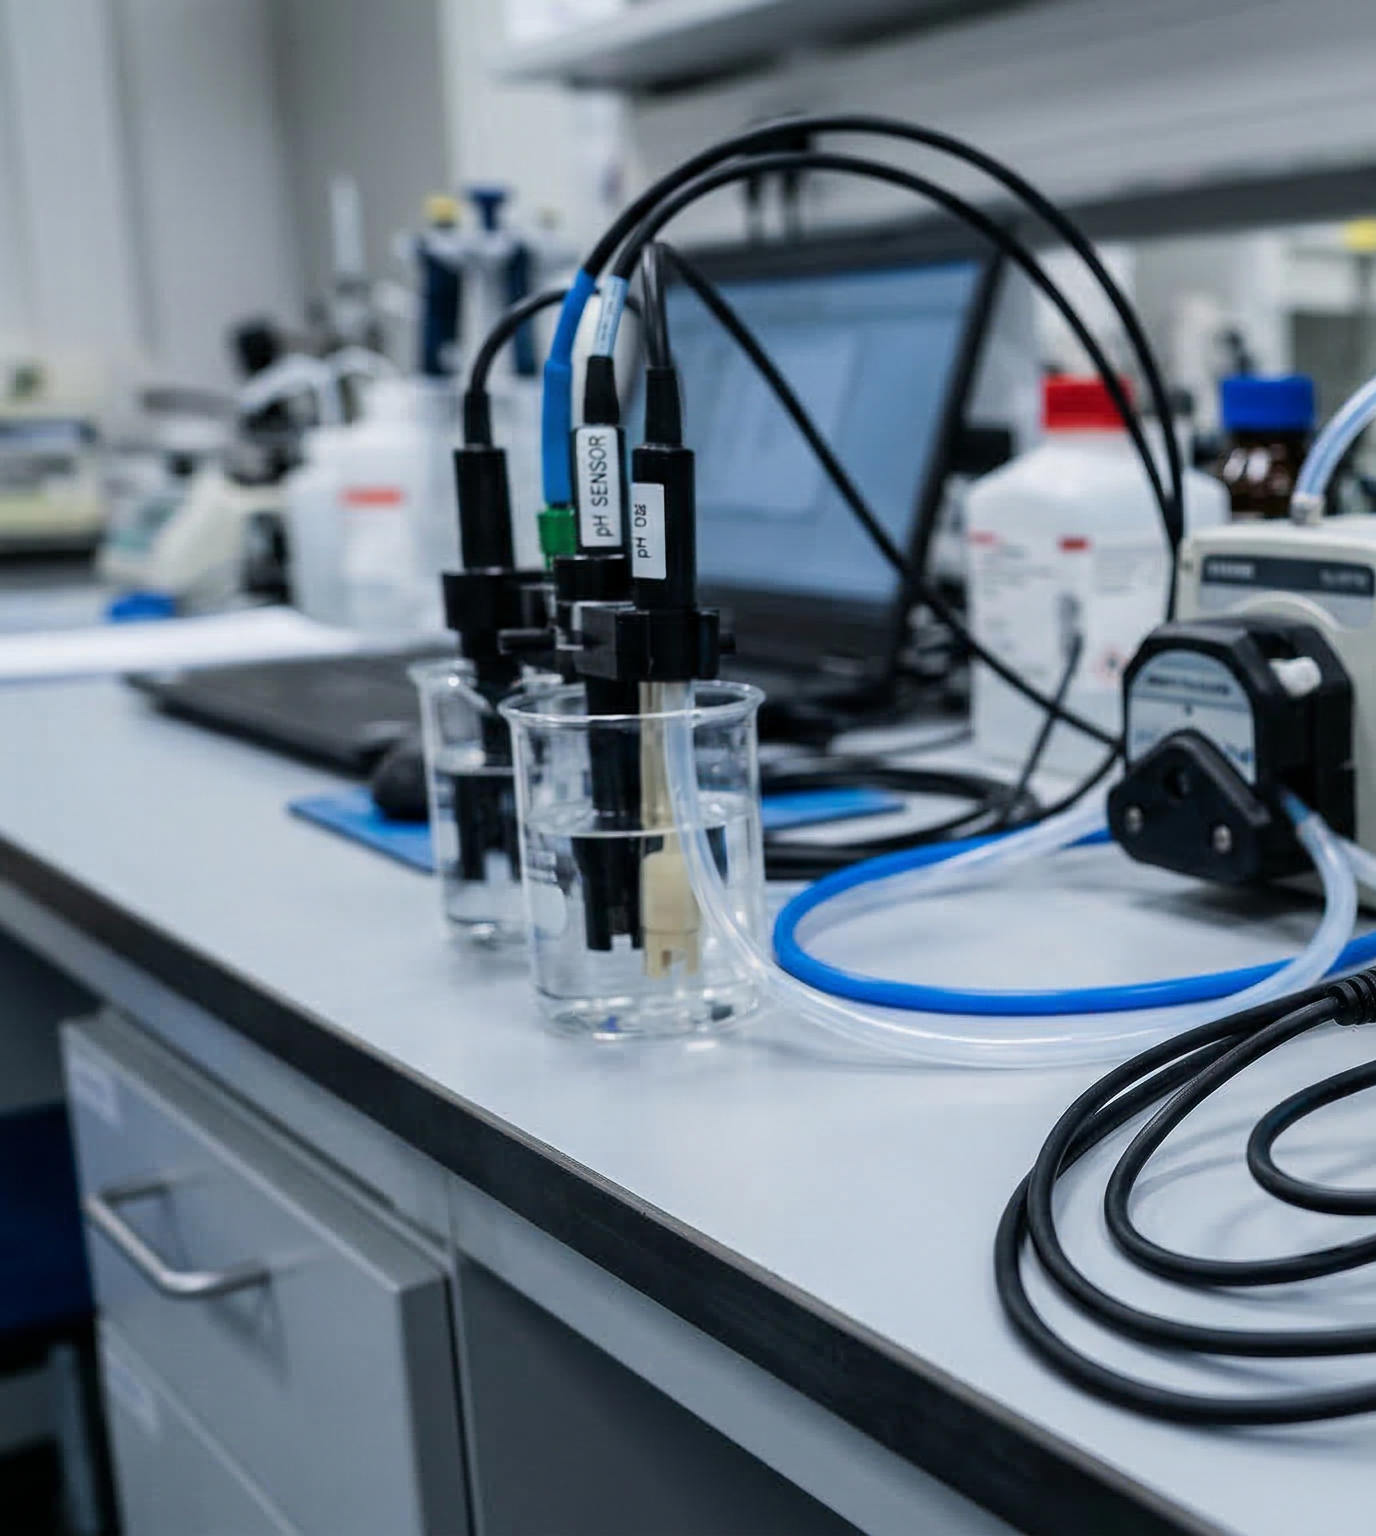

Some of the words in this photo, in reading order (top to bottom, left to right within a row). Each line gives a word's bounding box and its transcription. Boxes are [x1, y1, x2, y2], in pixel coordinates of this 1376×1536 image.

[587, 435, 609, 507] SENSOR
[592, 515, 614, 537] pH
[634, 537, 652, 559] pH
